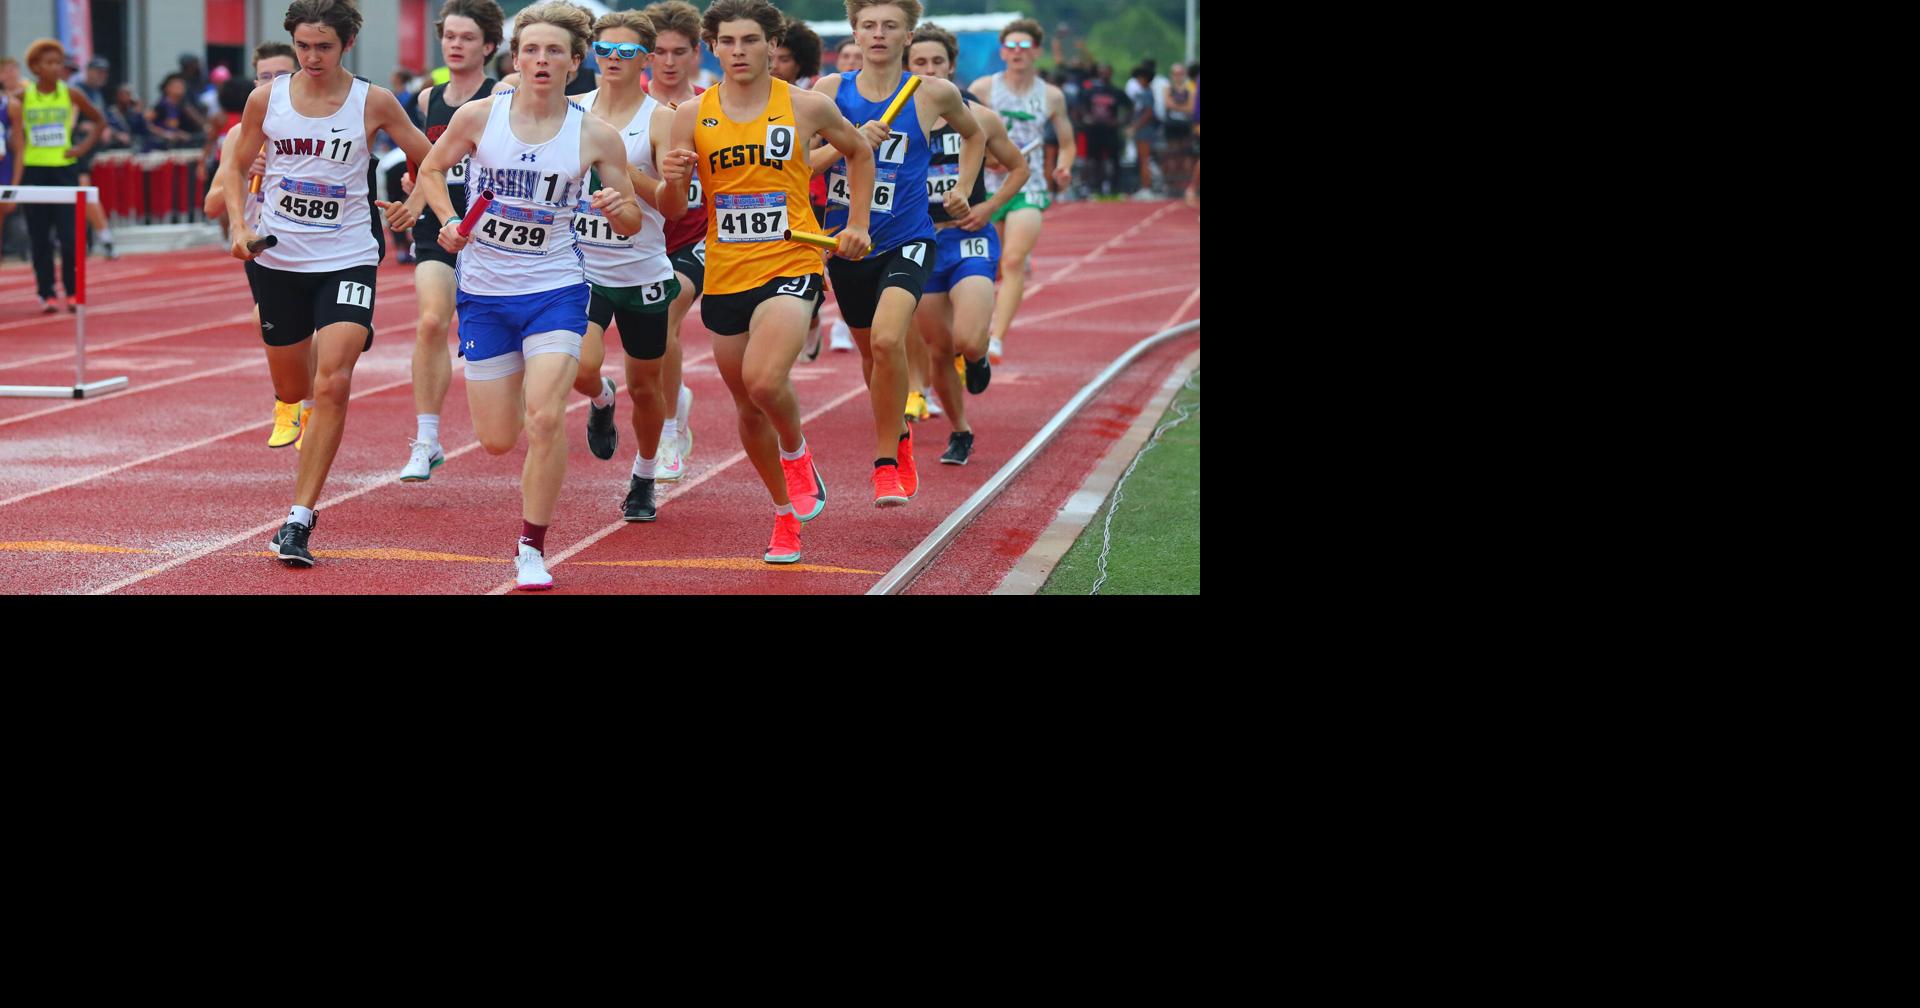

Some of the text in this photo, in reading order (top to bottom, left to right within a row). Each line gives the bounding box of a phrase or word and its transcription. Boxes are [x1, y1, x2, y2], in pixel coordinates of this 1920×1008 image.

[331, 138, 353, 161] 11
[770, 127, 791, 158] 9
[885, 133, 904, 160] 7
[948, 135, 960, 153] 1
[544, 174, 560, 201] 1
[833, 178, 889, 207] 46
[280, 195, 340, 220] 4589
[482, 218, 546, 247] 4739
[721, 210, 783, 235] 4187
[909, 242, 924, 260] 7
[965, 239, 985, 257] 16
[344, 282, 366, 305] 11
[645, 281, 662, 301] 3
[780, 275, 806, 294] 9
